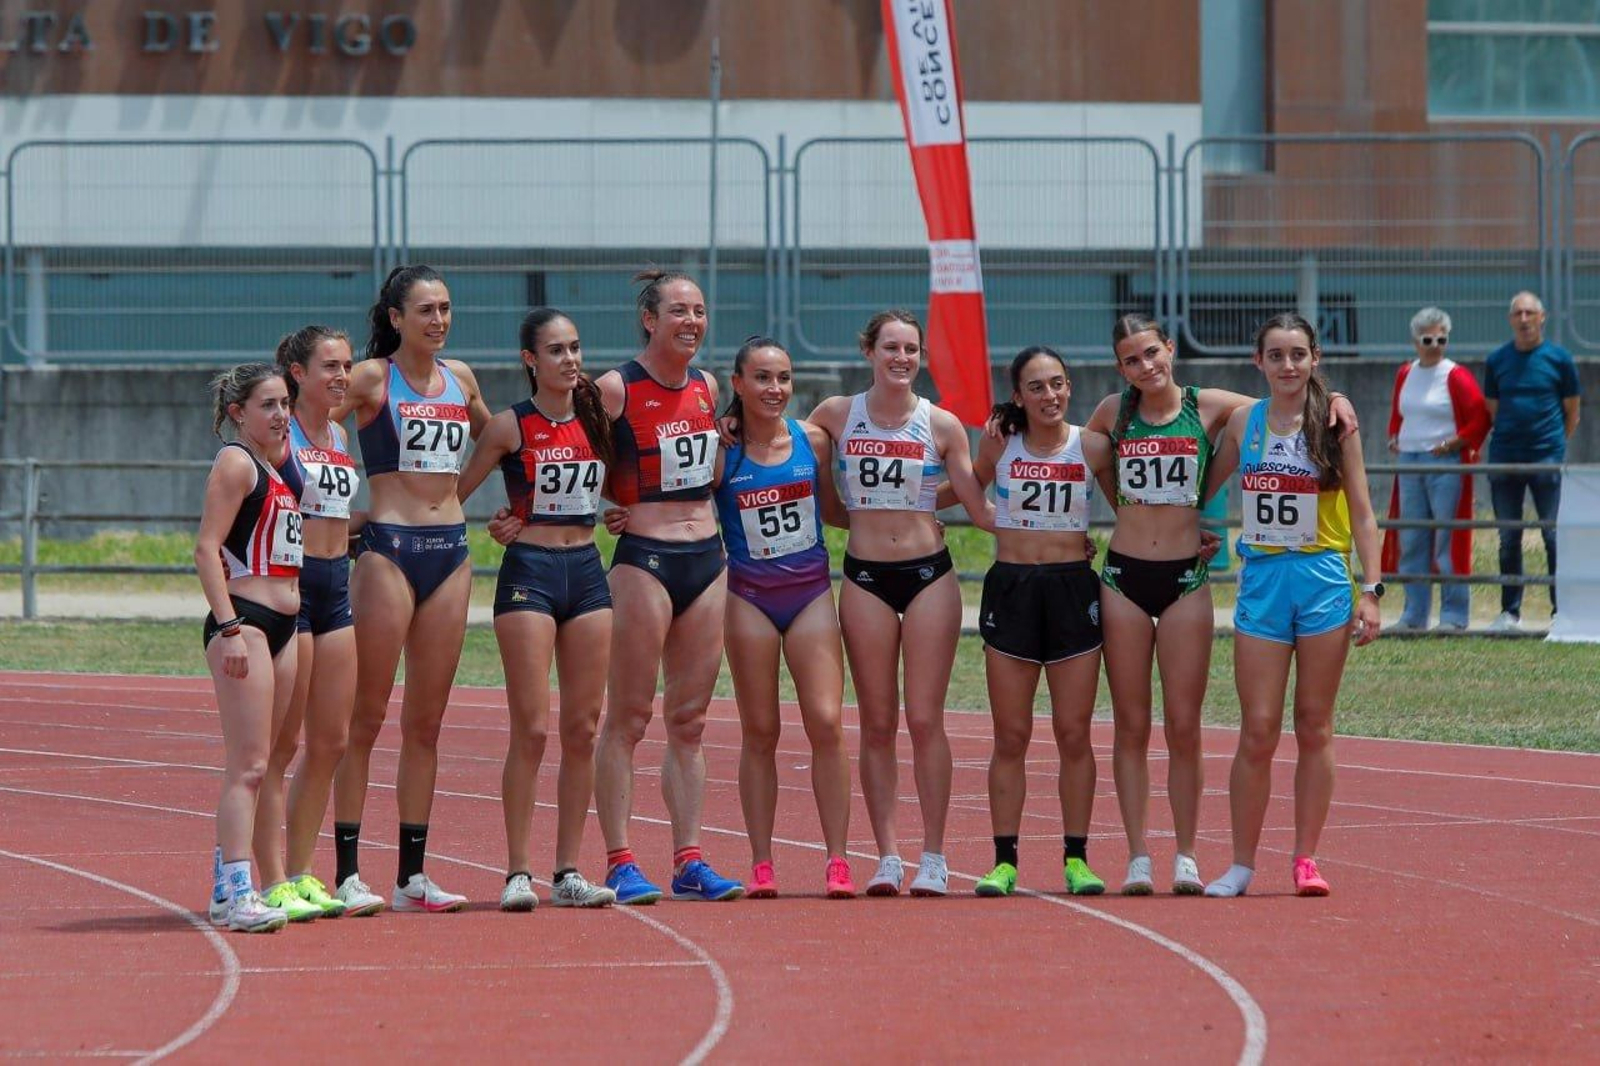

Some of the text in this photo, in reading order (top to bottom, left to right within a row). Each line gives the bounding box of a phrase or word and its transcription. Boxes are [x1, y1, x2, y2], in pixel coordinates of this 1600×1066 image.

[142, 11, 220, 53] DE
[264, 11, 417, 55] VIGO
[406, 419, 463, 452] 270
[675, 433, 707, 469] 97
[318, 465, 350, 497] 48
[540, 462, 598, 495] 374
[859, 457, 905, 489] 84
[1126, 456, 1188, 489] 314
[1021, 481, 1072, 513] 211
[1257, 493, 1298, 525] 66
[757, 501, 801, 537] 55
